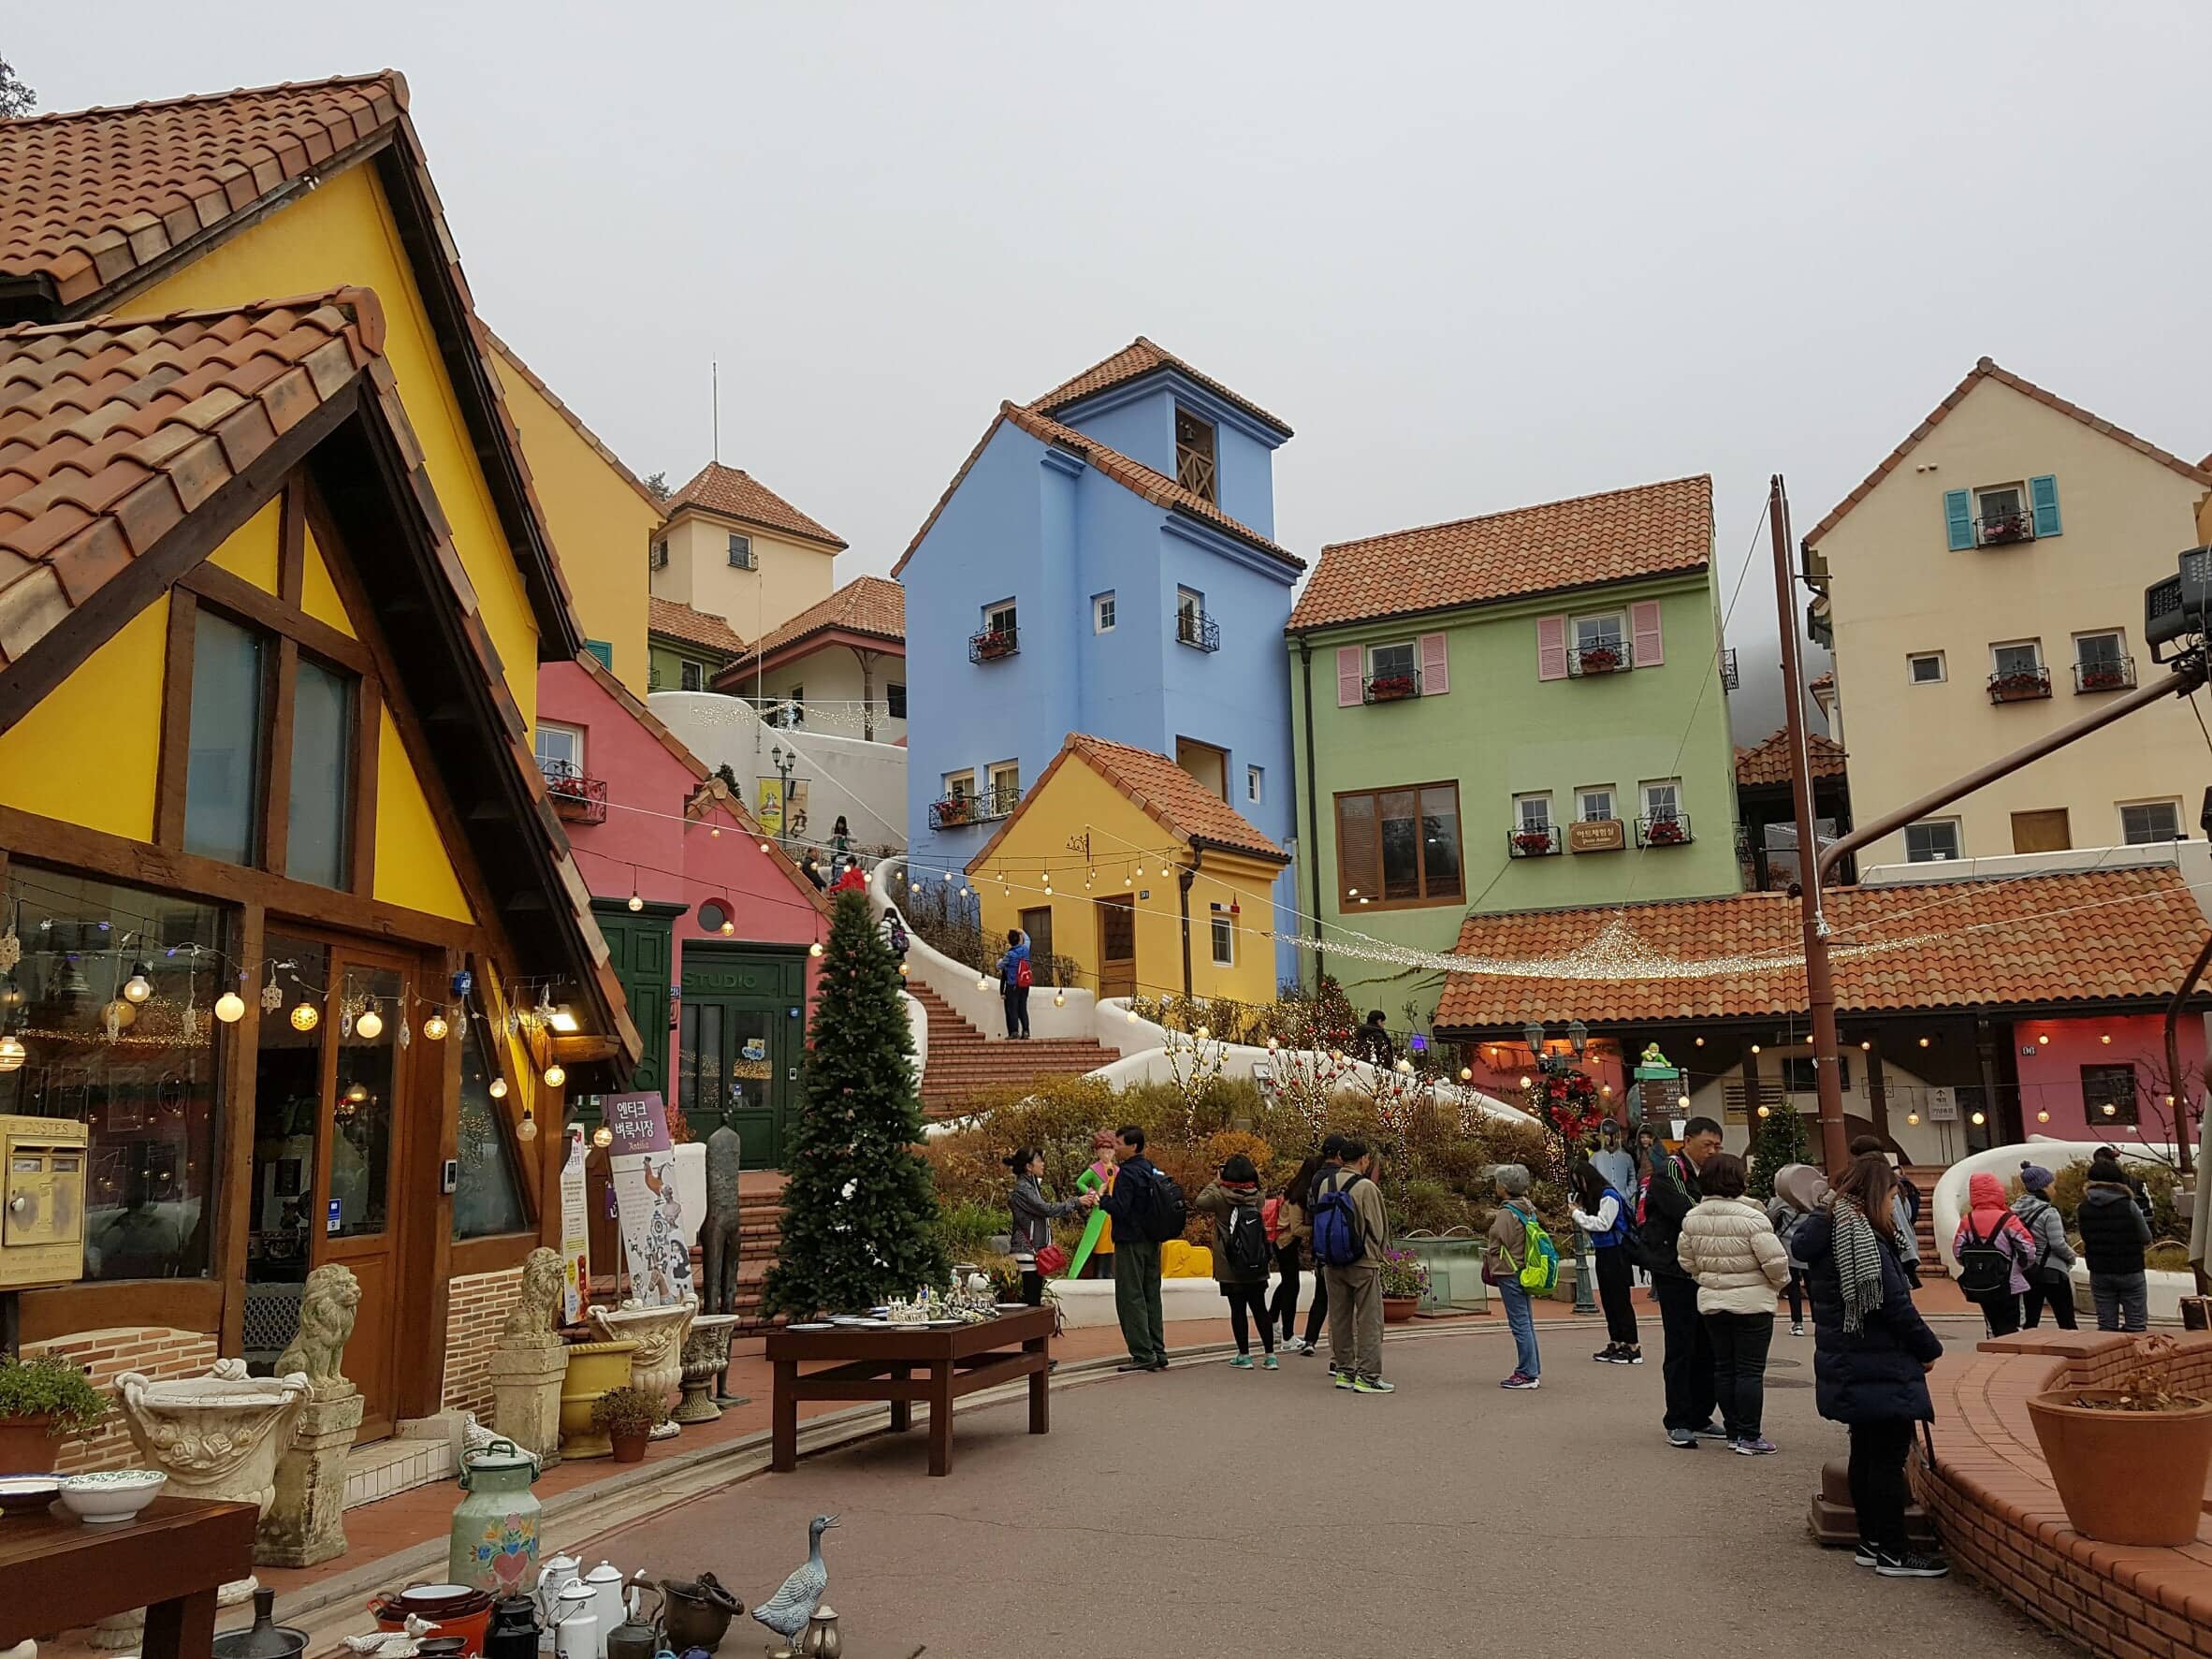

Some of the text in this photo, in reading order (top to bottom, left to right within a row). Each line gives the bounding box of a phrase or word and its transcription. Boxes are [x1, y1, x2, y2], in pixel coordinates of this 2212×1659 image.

[681, 972, 757, 989] STUDIO
[617, 1100, 648, 1119] 엔티크
[24, 1122, 68, 1135] POSTES
[615, 1120, 654, 1140] 벼룩시장
